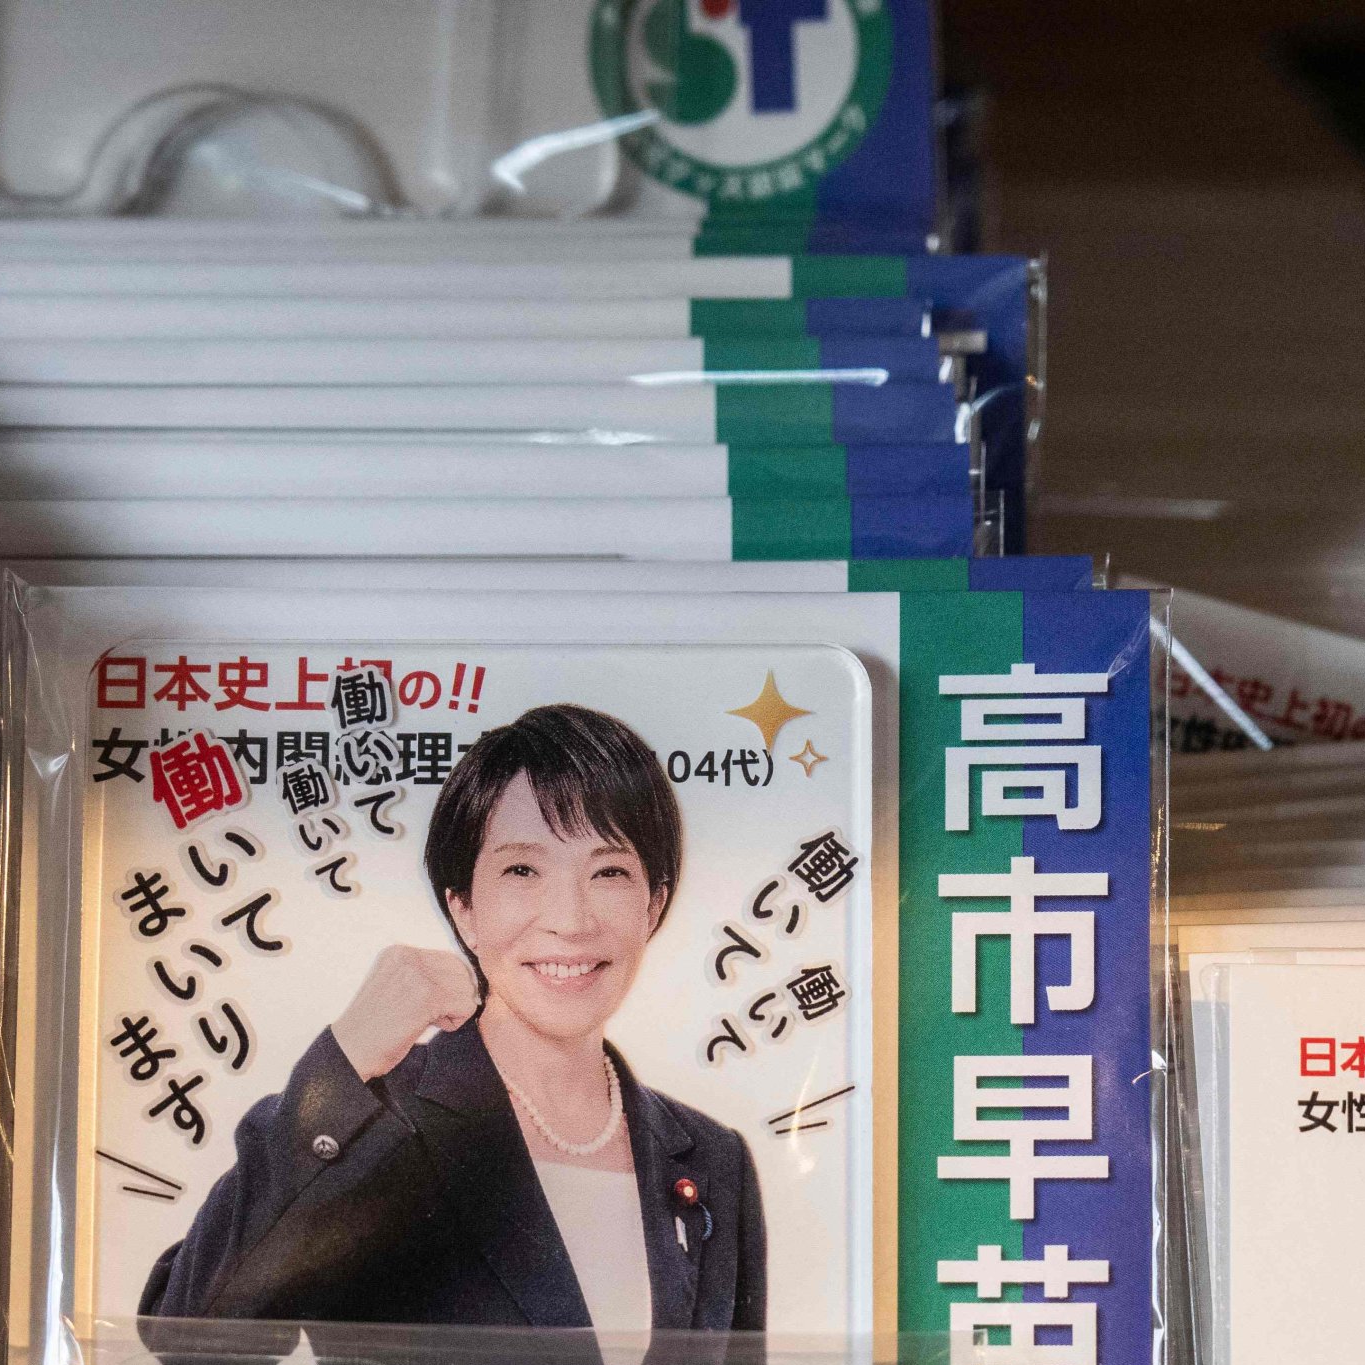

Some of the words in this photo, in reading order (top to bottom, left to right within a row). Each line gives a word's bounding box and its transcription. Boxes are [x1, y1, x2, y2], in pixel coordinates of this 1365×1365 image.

[331, 671, 397, 835] 働いて
[280, 763, 351, 893] 働いて
